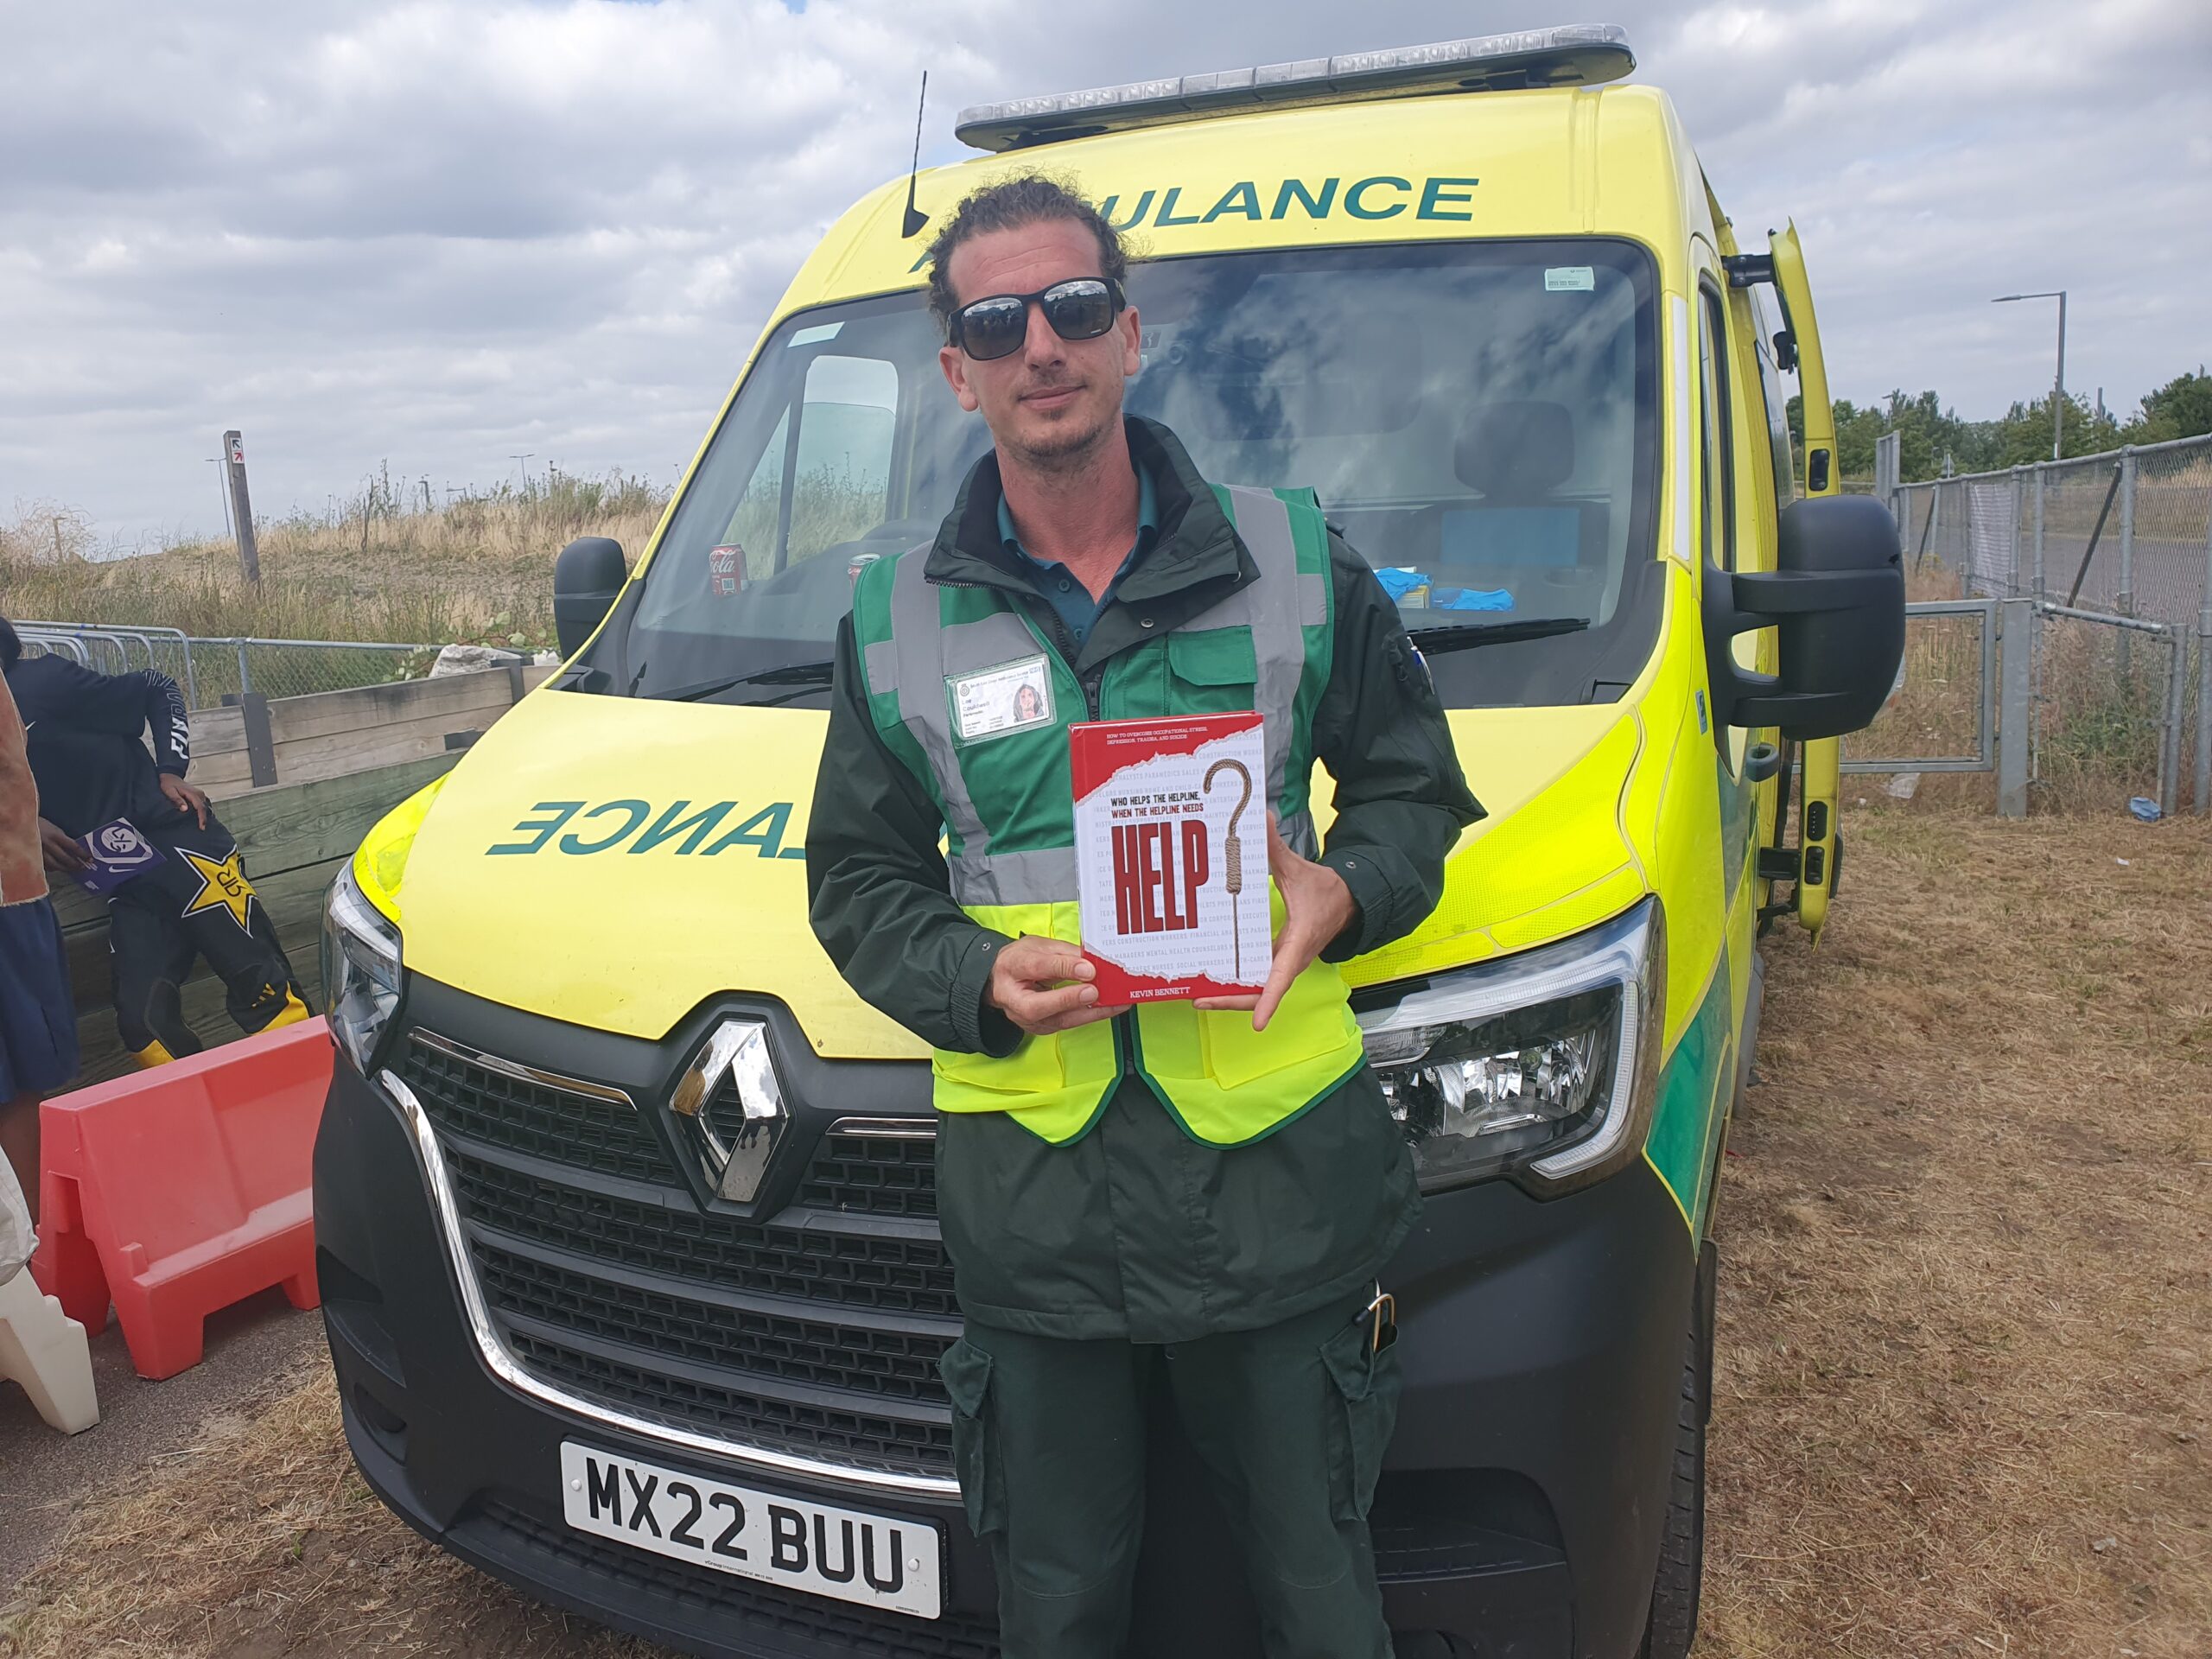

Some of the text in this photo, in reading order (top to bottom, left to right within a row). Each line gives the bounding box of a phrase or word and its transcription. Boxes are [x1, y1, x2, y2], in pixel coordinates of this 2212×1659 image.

[1110, 791, 1201, 807] WHO HELPS THE HELPLINE,
[1111, 808, 1132, 819] WHEN
[1135, 806, 1147, 817] THE
[1149, 804, 1180, 816] HELPLINE
[1182, 803, 1204, 813] NEEDS
[1111, 819, 1209, 935] HELP
[1129, 986, 1191, 999] KEVIN BENNETT
[586, 1456, 905, 1594] MX22 BUU
